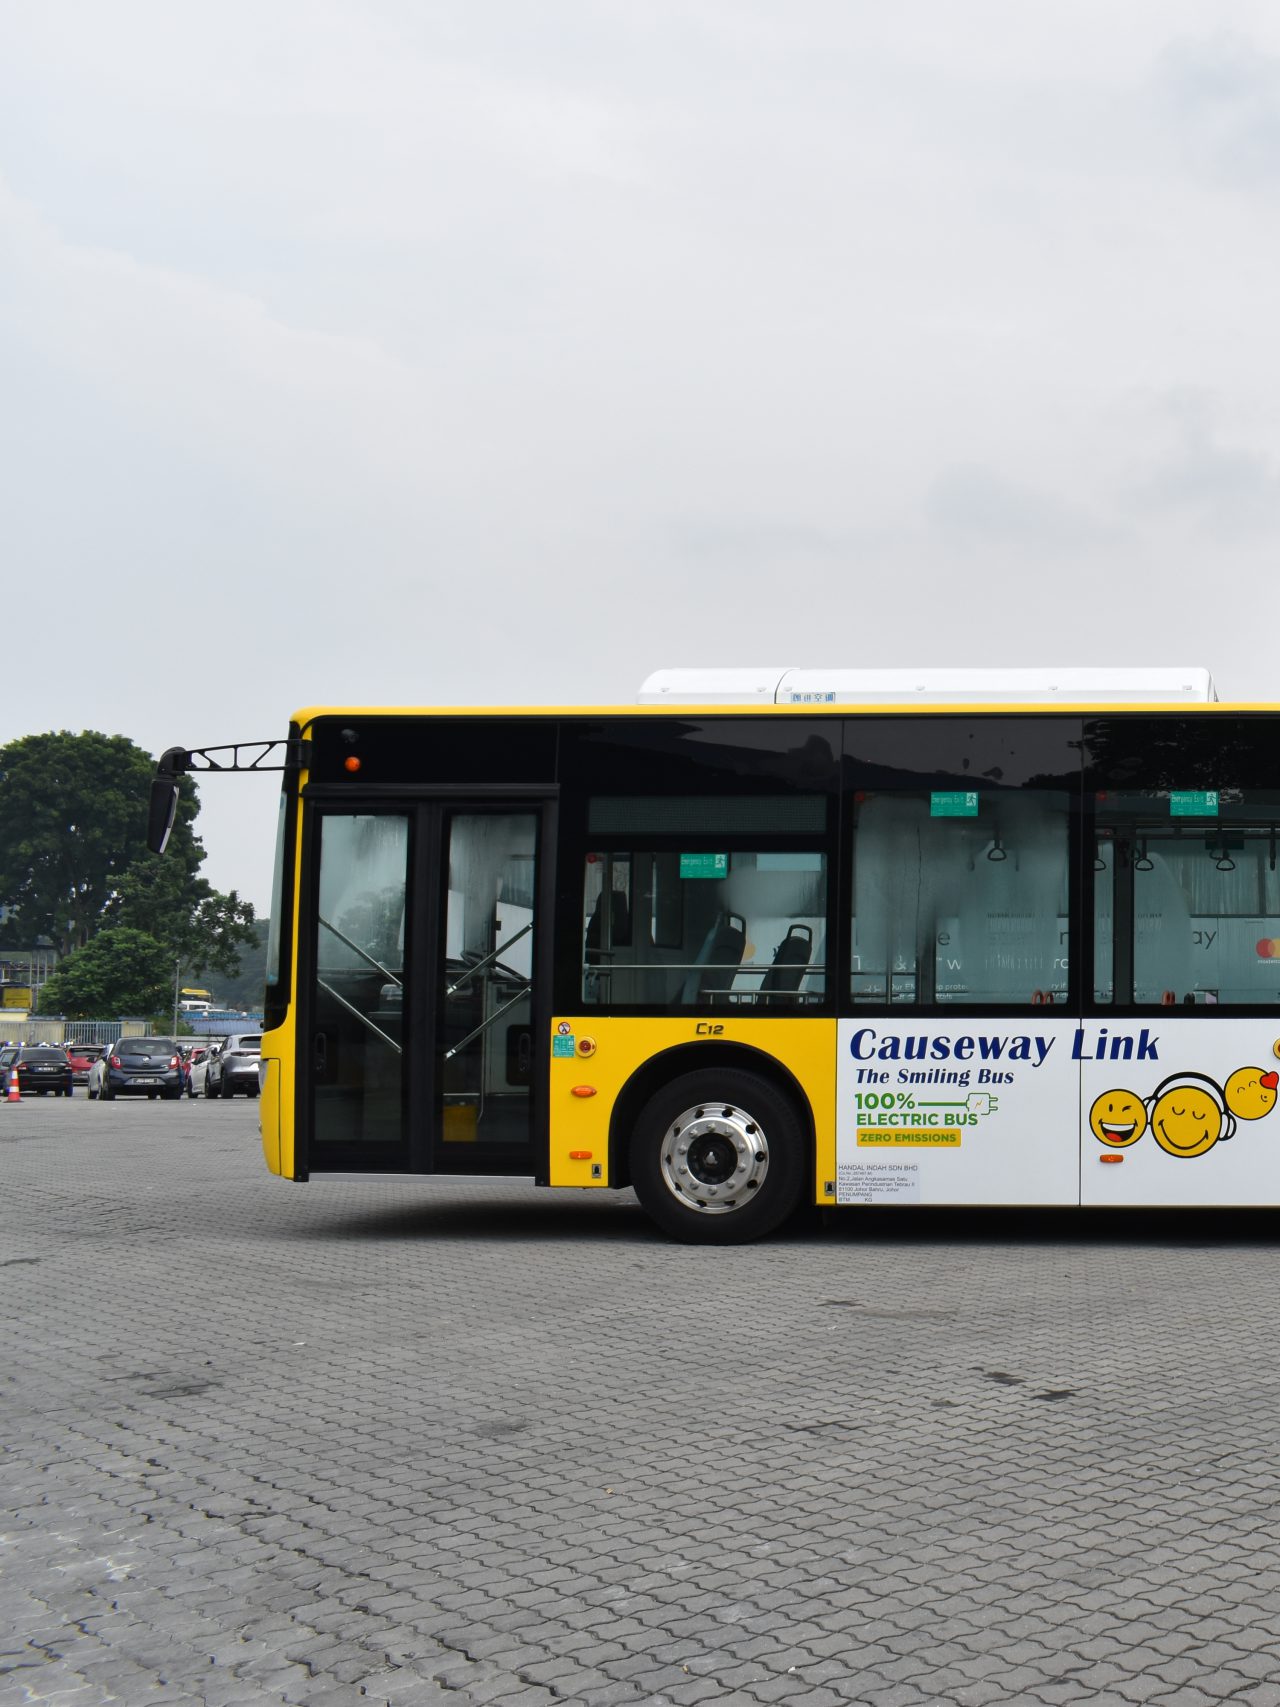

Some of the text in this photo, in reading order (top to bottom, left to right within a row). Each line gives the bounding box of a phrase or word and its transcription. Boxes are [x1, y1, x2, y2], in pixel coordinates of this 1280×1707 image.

[695, 1022, 725, 1035] C12
[850, 1028, 1160, 1067] Causeway Link
[856, 1068, 1014, 1088] The Smiling Bus
[854, 1093, 917, 1111] 100%
[856, 1113, 979, 1126] ELECTRIC BUS
[859, 1134, 957, 1143] ZERO EMISSIONS
